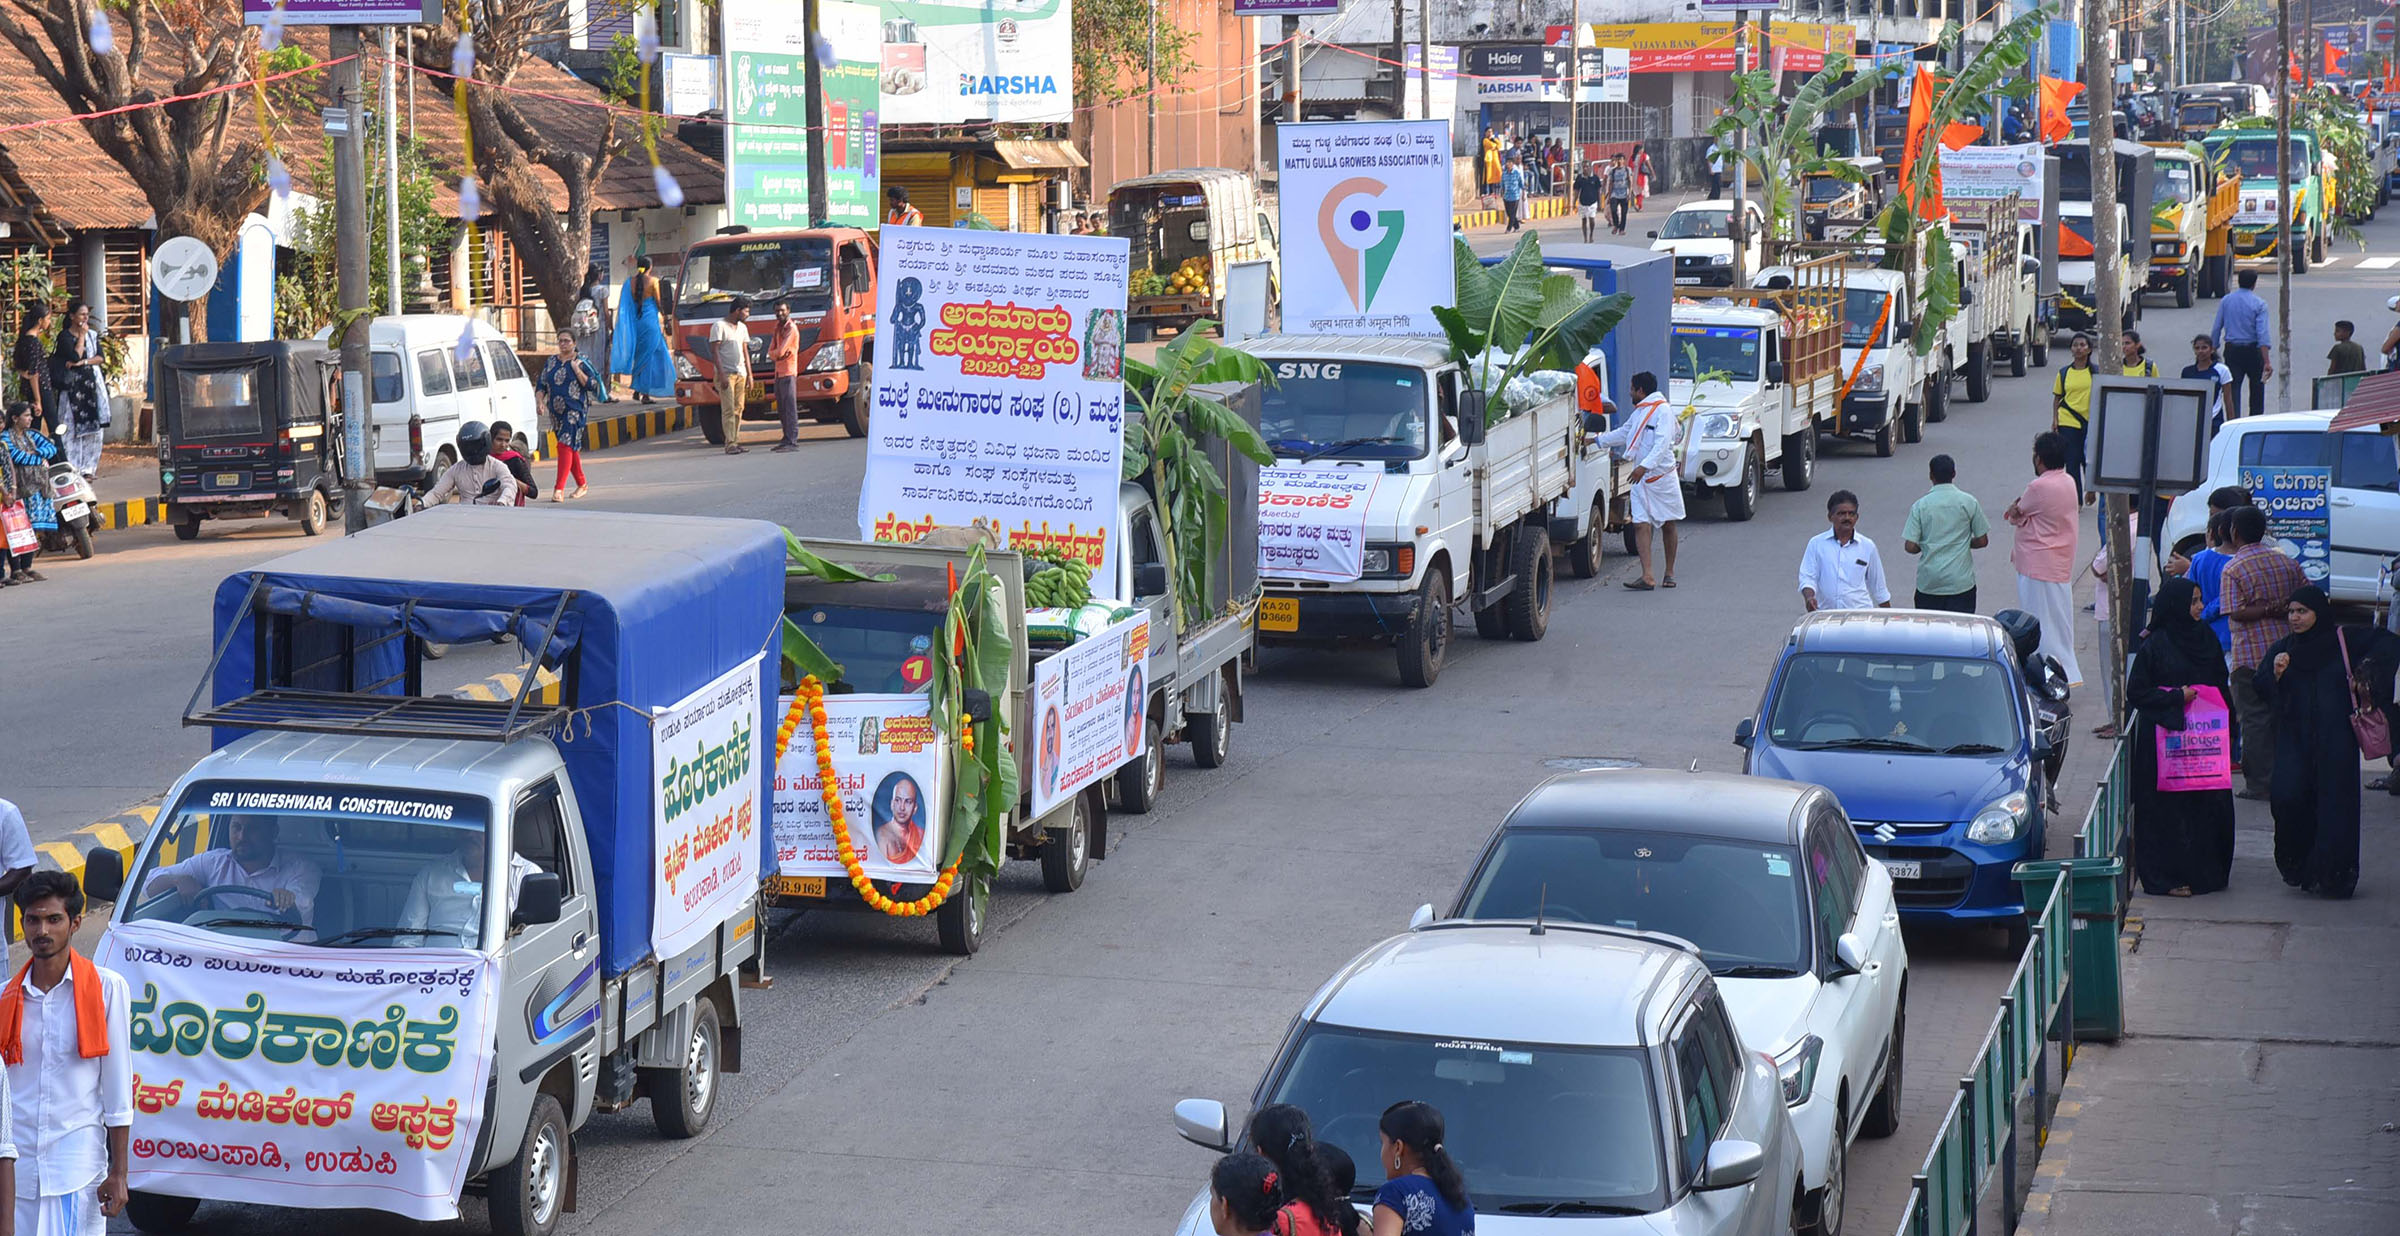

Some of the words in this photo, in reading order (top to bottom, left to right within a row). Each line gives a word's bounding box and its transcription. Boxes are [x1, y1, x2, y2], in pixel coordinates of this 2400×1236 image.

[1632, 40, 1667, 49] VIJAYA
[1670, 39, 1698, 48] BANK
[1488, 52, 1523, 64] Haier
[960, 73, 1057, 96] HARSHA
[1478, 82, 1533, 94] HARSHA
[1374, 134, 1392, 148] ಸಂಘ
[1285, 158, 1310, 170] MATTU
[1313, 157, 1337, 169] GULLA
[1339, 156, 1376, 168] GROWERS
[1379, 154, 1429, 167] ASSOCIATION
[1431, 154, 1443, 168] (R.)
[741, 242, 781, 252] SHARADA
[897, 240, 935, 257] ವಿಶ್ವಗುರು
[941, 242, 954, 257] ಶ್ರೀ
[1027, 249, 1058, 261] ಮೂಲ
[1063, 252, 1127, 270] ಮಹಾಸಂಸ್ಥಾನ
[898, 259, 949, 272] ಪರ್ಯಾಯ
[955, 262, 967, 277] ಶ್ರೀ
[973, 264, 1020, 276] ಅದಮಾರು
[1025, 267, 1054, 279] ಮಠದ
[1059, 270, 1088, 281] ಪರಮ
[1093, 273, 1123, 289] ಪೂಜ್ಯ
[928, 278, 941, 293] ಶ್ರೀ
[947, 280, 959, 295] ಶ್ರೀ
[1013, 285, 1041, 297] ತೀರ್ಥ
[1046, 286, 1089, 301] ಶ್ರೀಪಾದರ
[942, 302, 1069, 333] ಅದಮಾರು
[1309, 318, 1332, 332] अतुल्य
[1334, 317, 1353, 328] भारत
[1355, 316, 1367, 327] की
[1368, 316, 1391, 330] अमूल्य
[1393, 315, 1410, 328] निधि
[932, 330, 1078, 362] ಪರ್ಯಾಯ
[964, 358, 1042, 377] 2020-22
[1277, 362, 1341, 379] SNG
[879, 382, 909, 418] ಮಲ್ಪೆ
[917, 386, 1003, 415] ಮೀನುಗಾರರ
[1010, 390, 1045, 423] ಸಂಘ
[1053, 390, 1082, 426] (ರಿ.)
[883, 435, 914, 449] ಇದರ
[920, 436, 978, 461] ನೇತೃತ್ವದಲ್ಲಿ
[984, 442, 1016, 459] ವಿವಿಧ
[1023, 445, 1061, 460] ಭಜನಾ
[1067, 447, 1111, 463] ಮಂದಿರ
[914, 461, 951, 477] ಹಾಗೂ
[965, 465, 995, 482] ಸಂಘ
[2242, 470, 2264, 494] ಶ್ರೀ
[2273, 473, 2328, 490] ದುರ್ಗಾ
[1297, 523, 1322, 542] ಸಂಘ
[1326, 526, 1352, 547] ಮತ್ತು
[1260, 545, 1319, 567] ಗ್ರಾಮಸ್ಥರು
[1262, 601, 1277, 611] KA
[1278, 602, 1291, 611] 20
[907, 660, 924, 680] 1
[661, 721, 681, 743] ಉಡುಪಿ
[684, 700, 715, 730] ಪರ್ಯಾಯ
[718, 676, 753, 708] ಮಹೋತ್ಸವಕ್ಕೆ
[884, 716, 932, 729] ಅದಮಾರು
[880, 731, 934, 743] ಪರ್ಯಾಯ
[891, 744, 922, 752] 2020-22
[2183, 734, 2221, 748] House
[662, 711, 751, 824] ಹೊರೆಕಾಣಿಕೆ
[210, 791, 232, 808] SRI
[236, 792, 333, 812] VIGNESHWARA
[339, 797, 454, 820] CONSTRUCTIONS
[799, 799, 819, 814] ಸಂಘ
[664, 833, 688, 896] ಹೈಟೆಕ್
[693, 806, 733, 865] ಮೆಡಿಕೇರ್
[722, 852, 742, 884] ಉಡುಪಿ
[125, 946, 192, 968] ಉಡುಪಿ
[336, 968, 474, 997] ಮಹೋತ್ಸವಕ್ಕೆ
[1435, 1041, 1467, 1050] POOJA
[197, 1081, 355, 1129] ಮೆಡಿಕೇರ್
[132, 1137, 291, 1172] ಅಂಬಲಪಾಡಿ,
[306, 1146, 397, 1175] ಉಡುಪಿ
